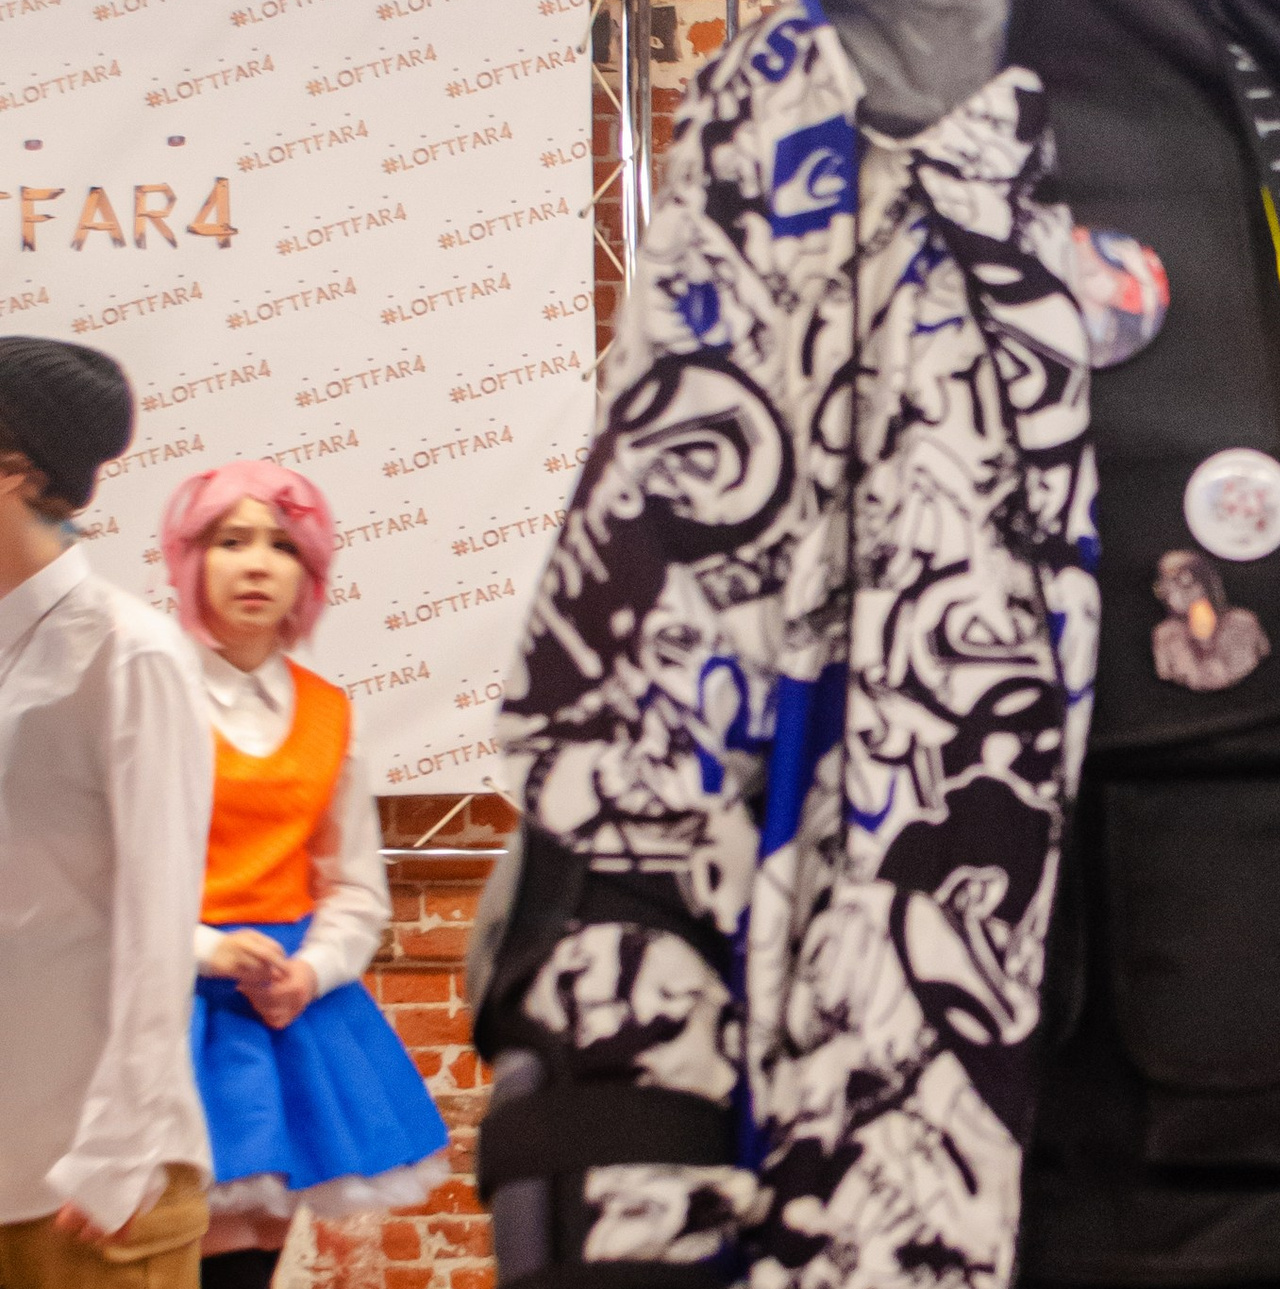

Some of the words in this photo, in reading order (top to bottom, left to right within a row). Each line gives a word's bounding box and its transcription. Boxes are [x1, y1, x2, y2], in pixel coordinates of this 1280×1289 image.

[145, 55, 275, 108] #LOFTFAR4
[306, 44, 438, 97] #LOFTFAR4
[446, 45, 577, 99] #LOFTFAR4
[237, 120, 369, 173] #LOFTFAR4
[382, 123, 514, 175] #LOFTFAR4
[0, 176, 239, 253] FAR4
[276, 203, 408, 256] #LOFTFAR4
[438, 197, 570, 251] #LOFTFAR4
[72, 281, 203, 334] #LOFTFAR4
[227, 276, 358, 329] #LOFTFAR4
[381, 272, 512, 325] #LOFTFAR4
[142, 359, 272, 412] #LOFTFAR4
[295, 355, 427, 408] #LOFTFAR4
[450, 351, 582, 404] #LOFTFAR4
[382, 425, 514, 478] #LOFTFAR4
[384, 578, 516, 632] #LOFTFAR4
